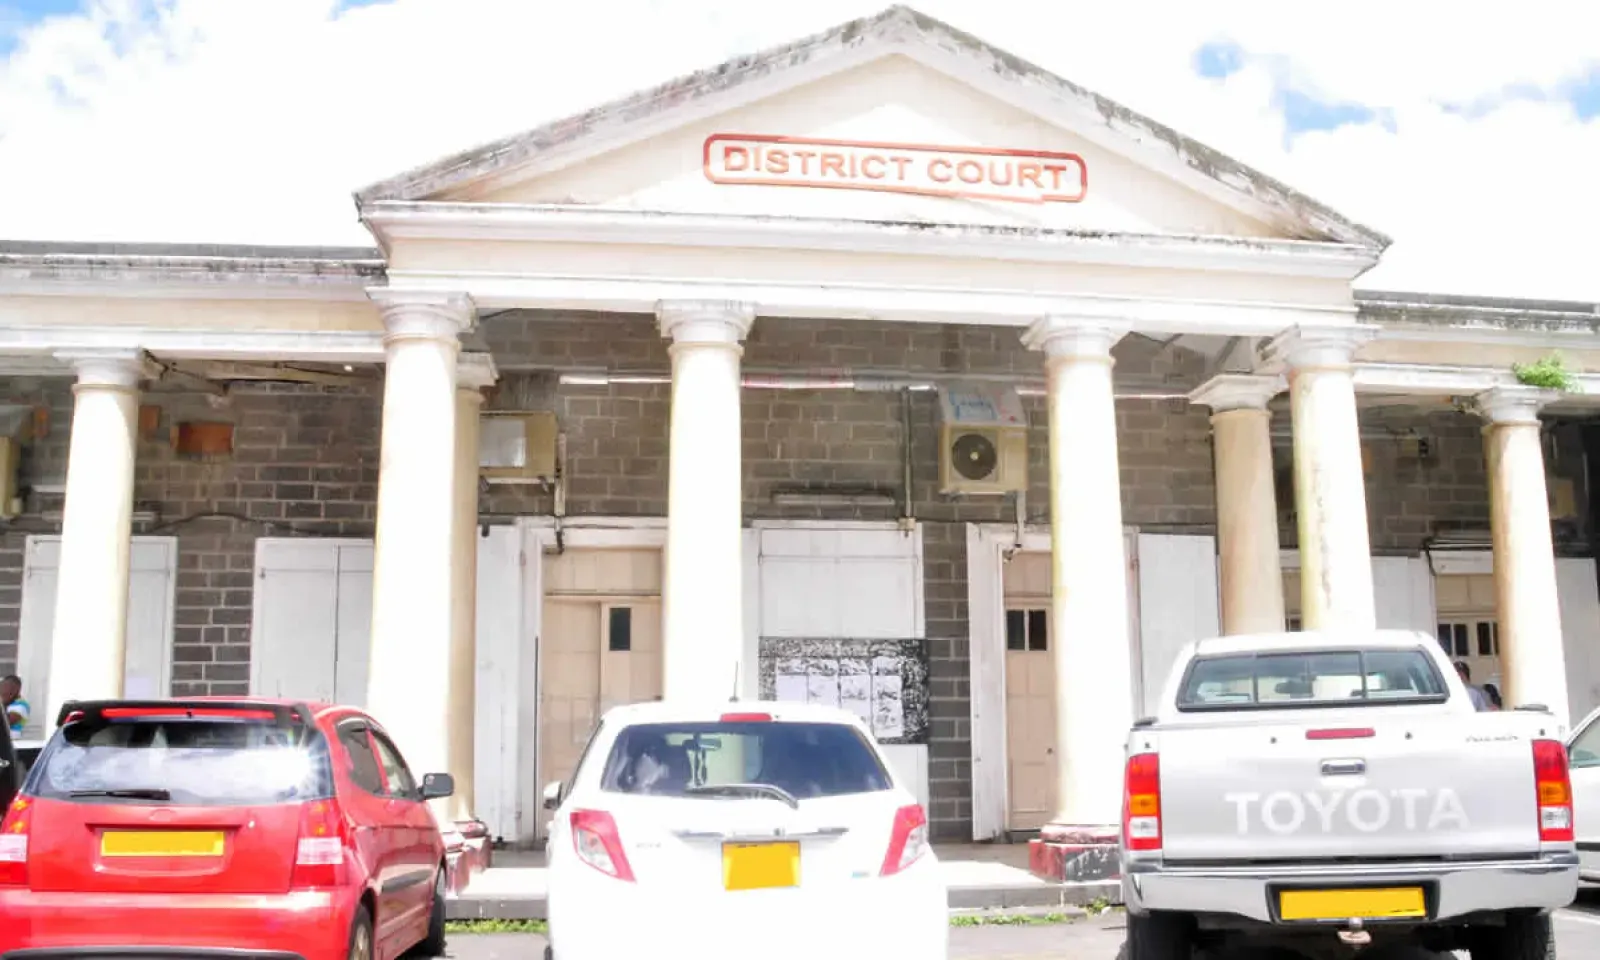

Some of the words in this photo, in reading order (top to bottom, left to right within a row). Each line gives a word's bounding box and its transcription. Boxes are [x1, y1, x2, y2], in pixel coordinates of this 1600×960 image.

[724, 145, 913, 180] DISTRICT
[927, 159, 1067, 190] COURT
[1224, 788, 1471, 834] TOYOTA
